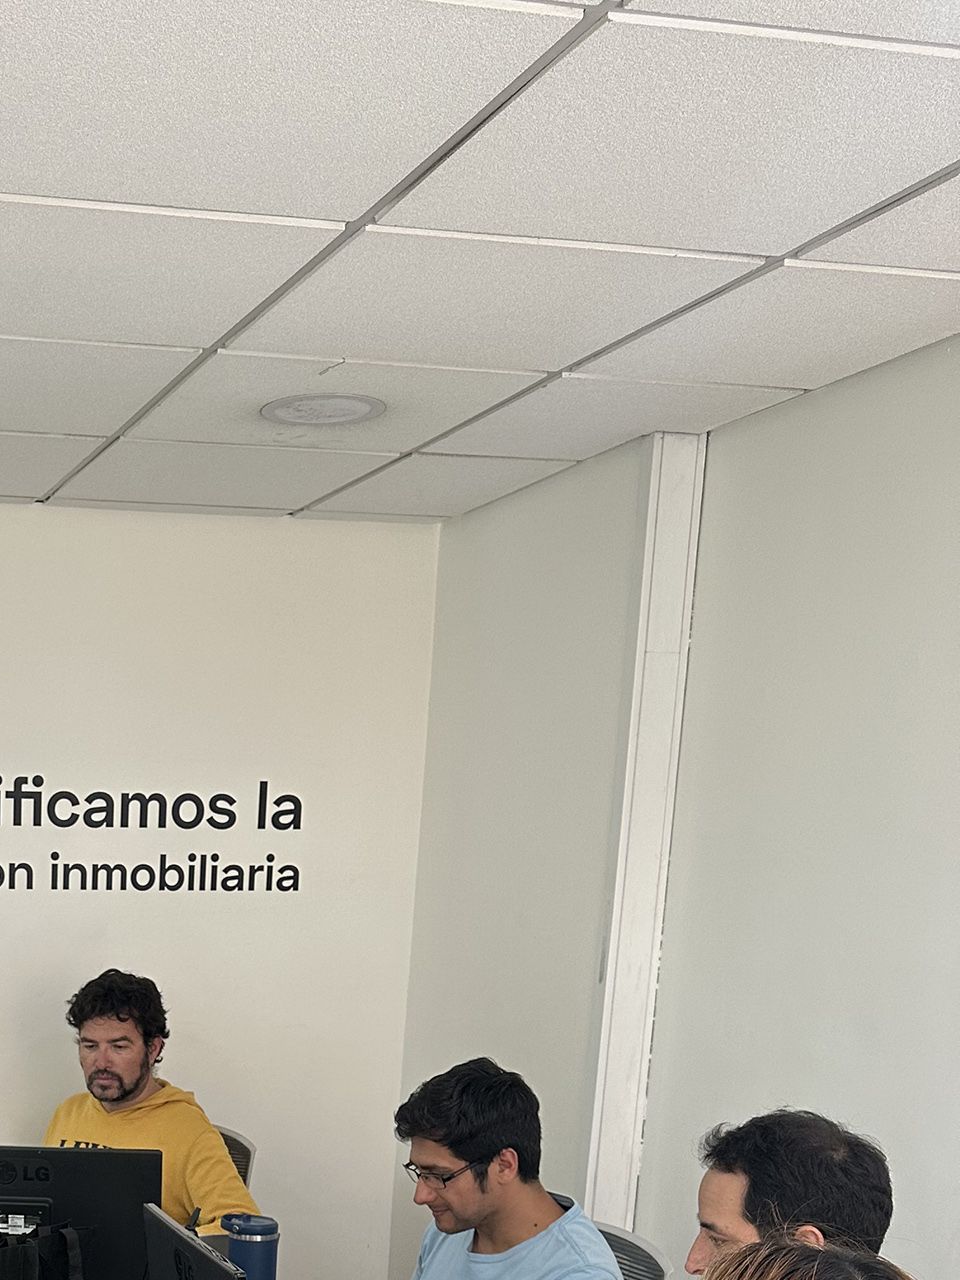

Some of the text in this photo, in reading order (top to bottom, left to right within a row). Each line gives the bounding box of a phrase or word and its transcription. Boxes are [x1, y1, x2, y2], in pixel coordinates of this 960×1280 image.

[256, 780, 304, 831] la
[49, 850, 300, 892] inmobiliaria
[23, 1165, 50, 1182] LG
